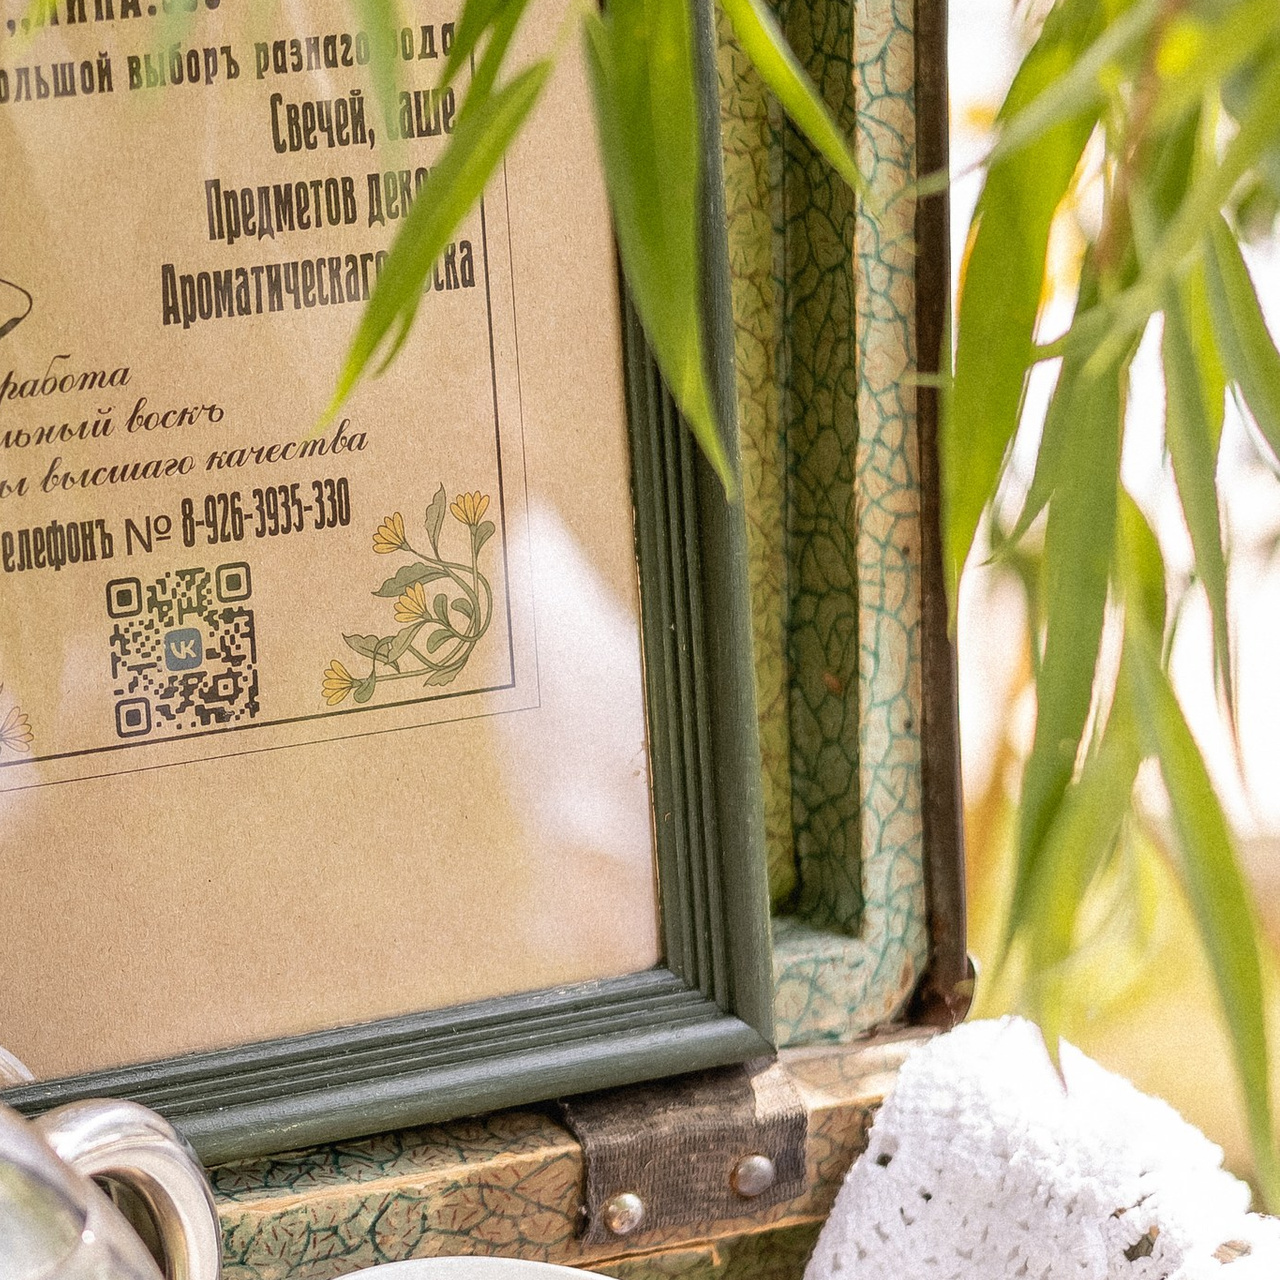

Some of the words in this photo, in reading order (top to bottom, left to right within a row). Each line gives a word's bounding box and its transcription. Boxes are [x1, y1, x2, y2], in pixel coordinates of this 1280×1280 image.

[127, 41, 241, 91] выборъ
[255, 30, 370, 80] разнаго
[270, 88, 375, 154] Свечей,
[205, 177, 357, 245] Предметов
[125, 397, 225, 433] воскъ
[40, 456, 195, 493] высшаго
[205, 418, 369, 472] качества
[181, 477, 351, 548] 8-926-3935-330
